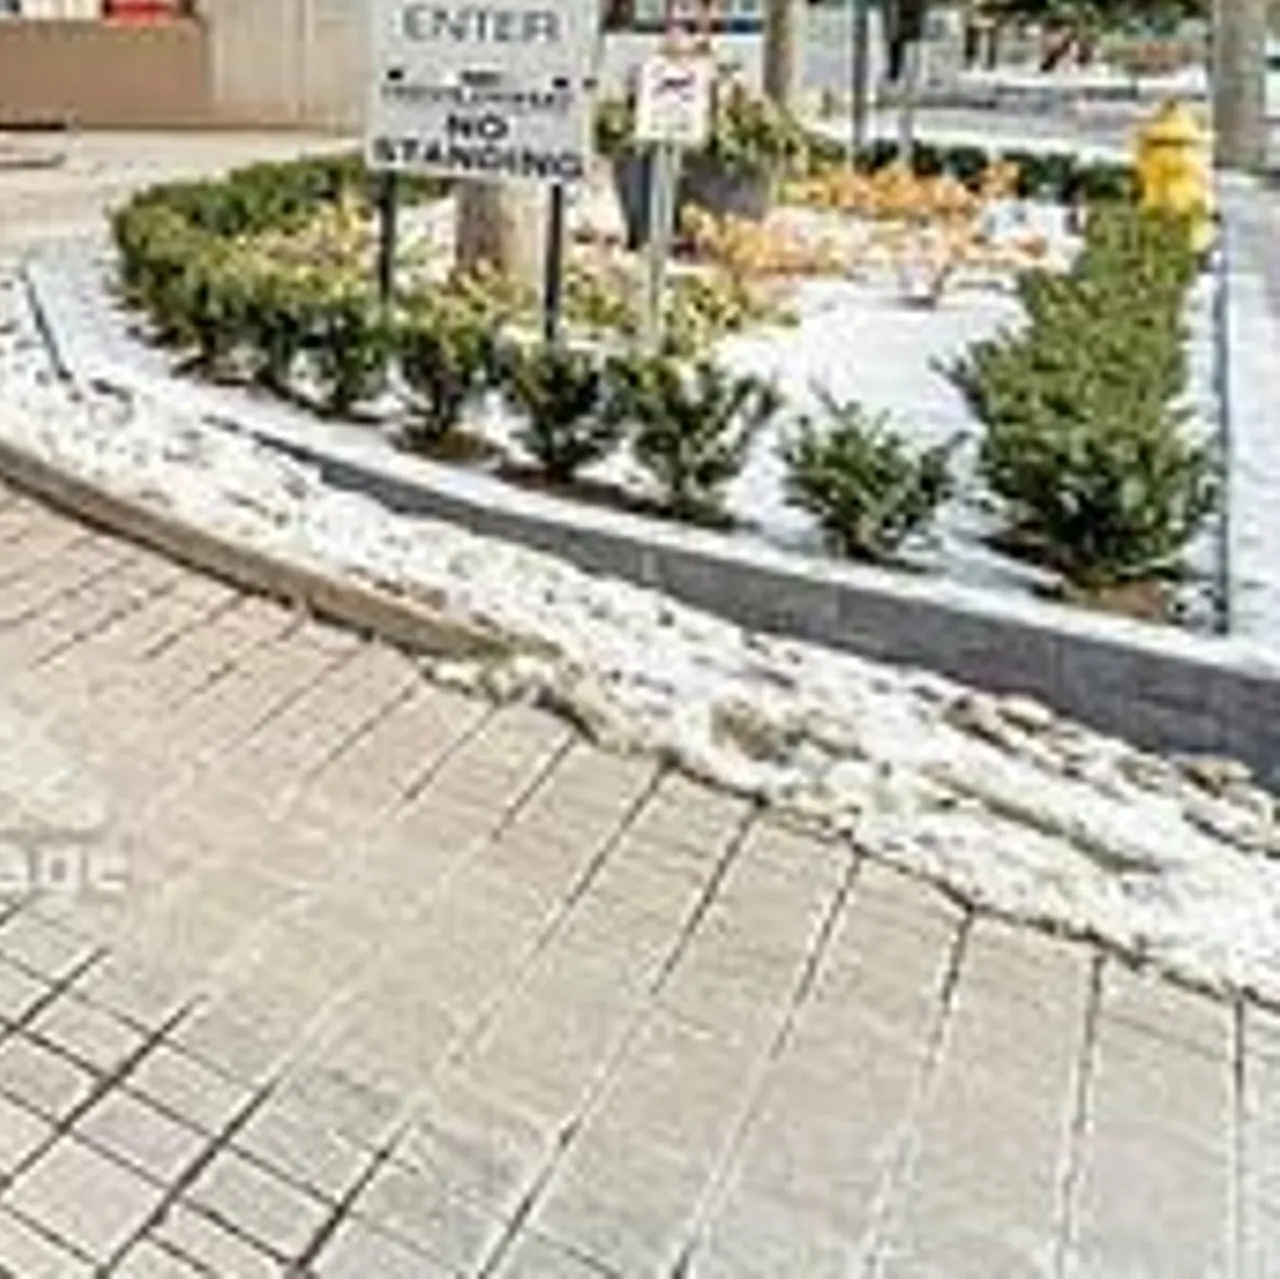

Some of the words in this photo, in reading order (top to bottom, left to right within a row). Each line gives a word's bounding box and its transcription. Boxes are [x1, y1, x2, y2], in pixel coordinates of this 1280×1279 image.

[403, 4, 562, 44] ENTER
[447, 113, 509, 142] NO
[372, 137, 584, 180] STANDING
